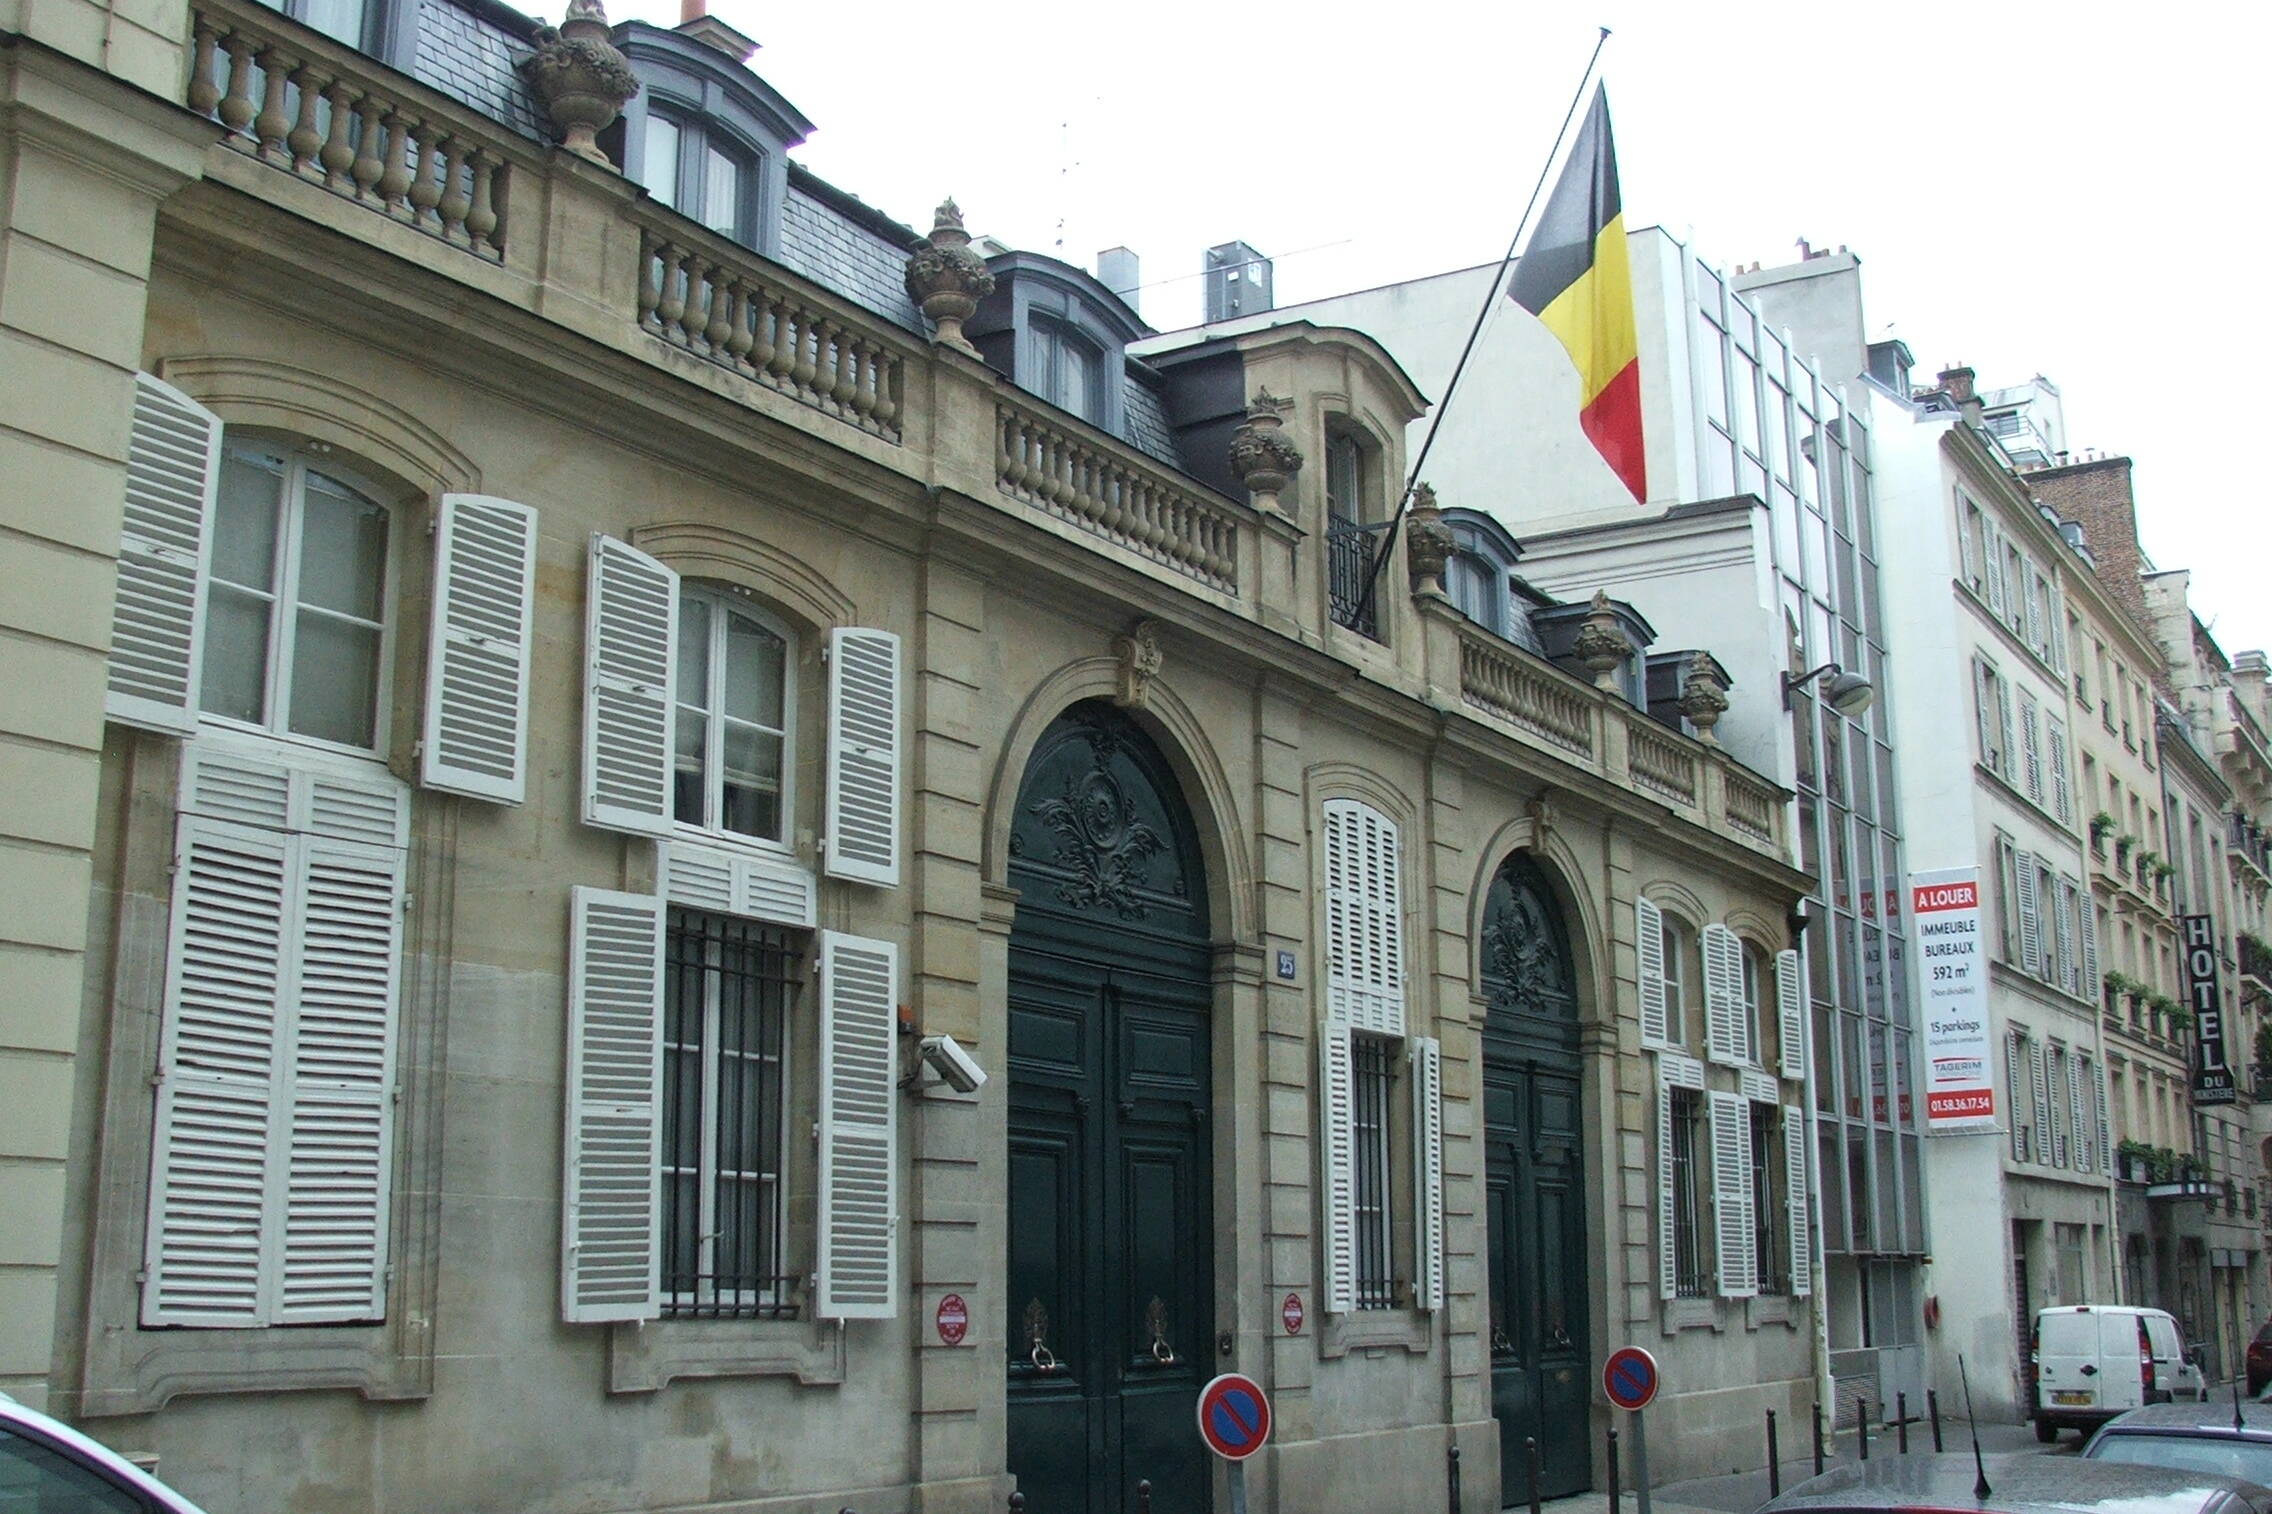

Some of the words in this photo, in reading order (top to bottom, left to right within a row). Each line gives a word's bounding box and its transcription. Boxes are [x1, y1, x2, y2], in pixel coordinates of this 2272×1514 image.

[1918, 891, 1928, 908] A
[1930, 887, 1974, 906] LOUER
[1921, 919, 1976, 936] IMMEUBLE
[1925, 941, 1974, 958] BUREAUX
[1280, 954, 1294, 975] 25
[1933, 965, 1952, 980] 592
[2186, 917, 2225, 1071] HOTEL
[1930, 1021, 1940, 1033] 15
[1941, 1020, 1980, 1035] parkings
[1934, 1061, 1982, 1073] TAGERIM
[2203, 1075, 2225, 1088] DU
[1930, 1096, 1990, 1112] 01.58.36.17.54
